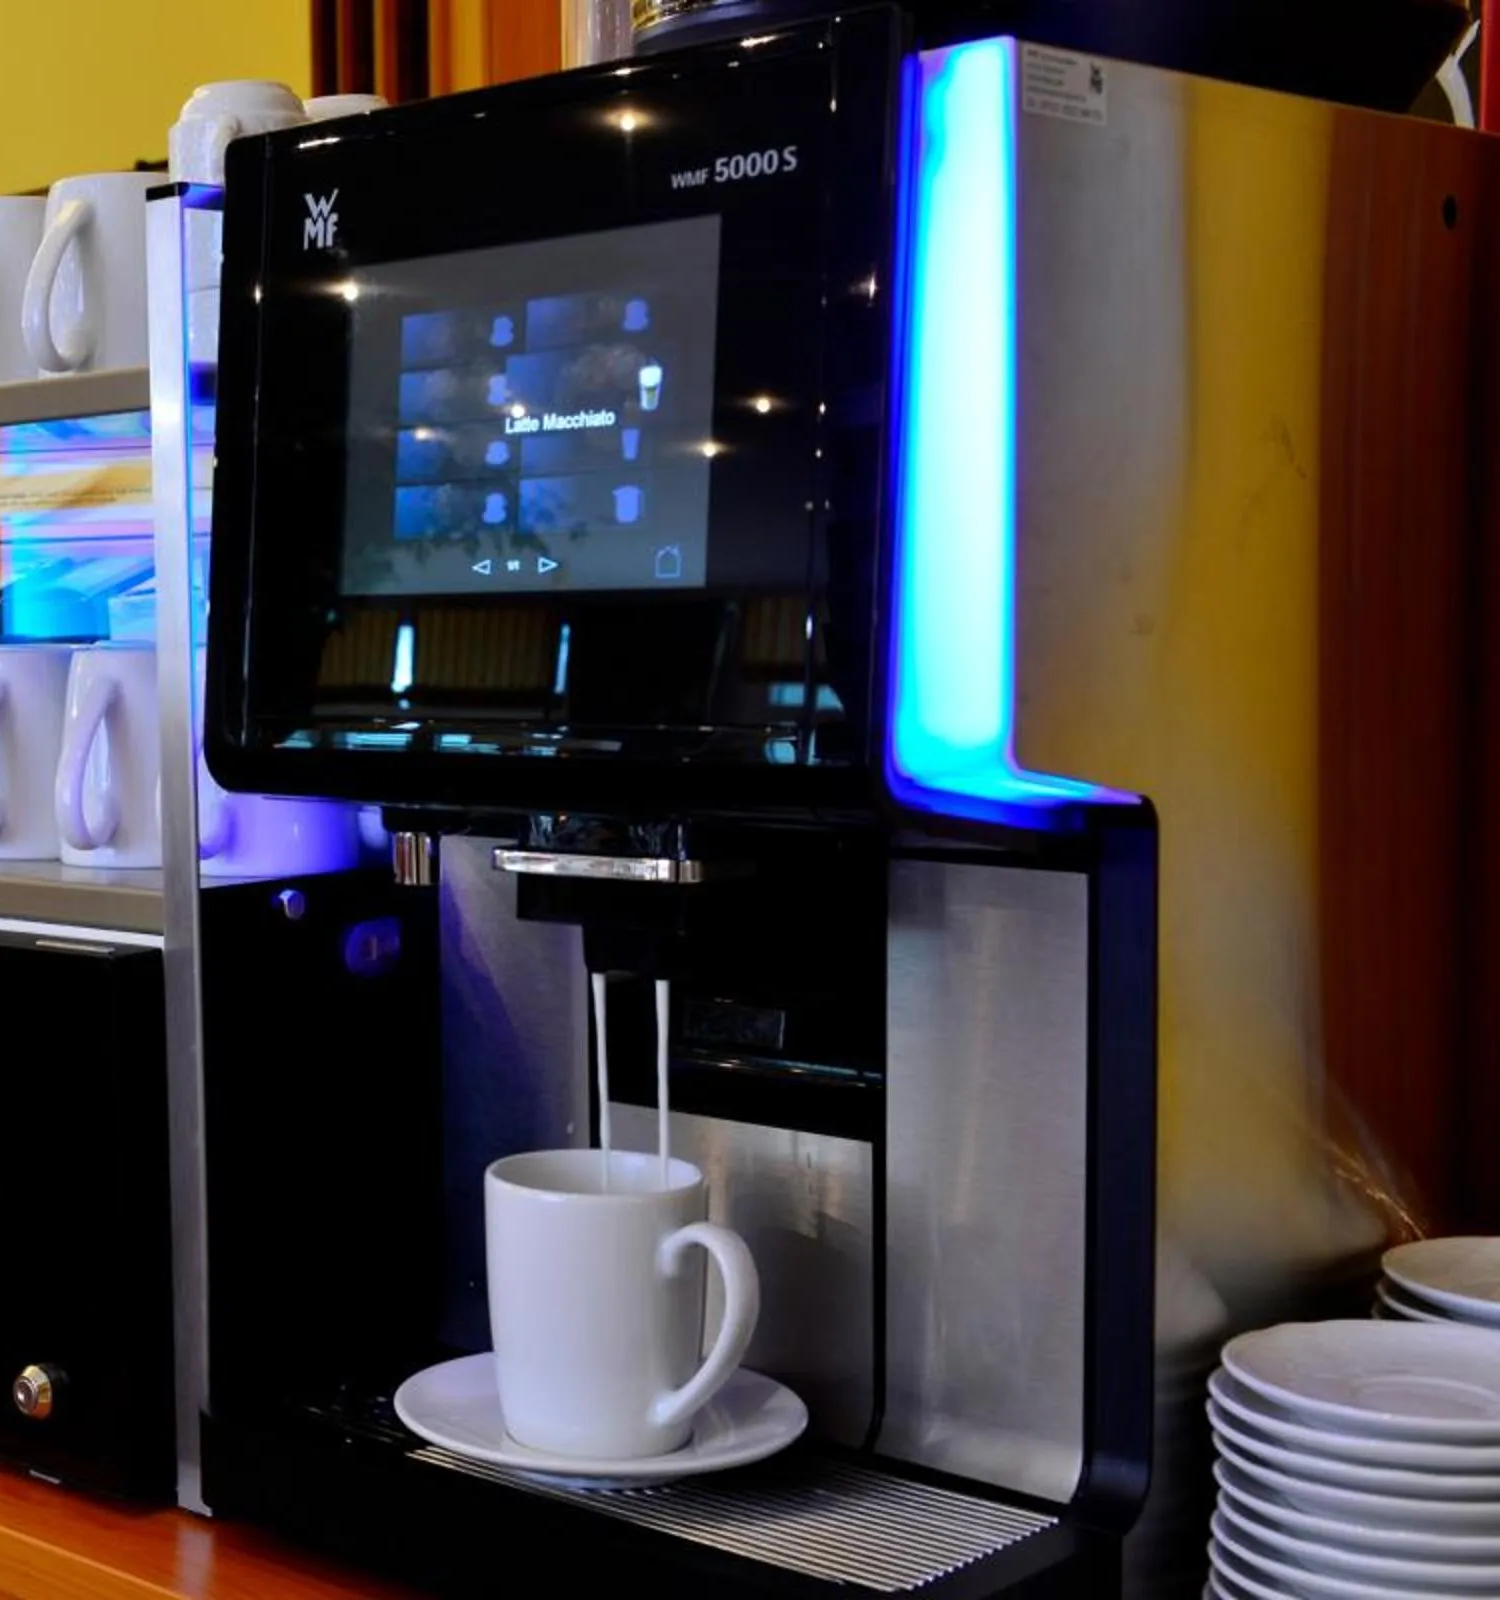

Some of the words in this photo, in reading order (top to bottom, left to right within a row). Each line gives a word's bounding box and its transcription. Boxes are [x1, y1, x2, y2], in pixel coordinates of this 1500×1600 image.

[671, 167, 709, 189] WMF
[714, 149, 779, 182] 5000
[505, 415, 540, 434] Latte
[543, 408, 616, 431] Macchiato
